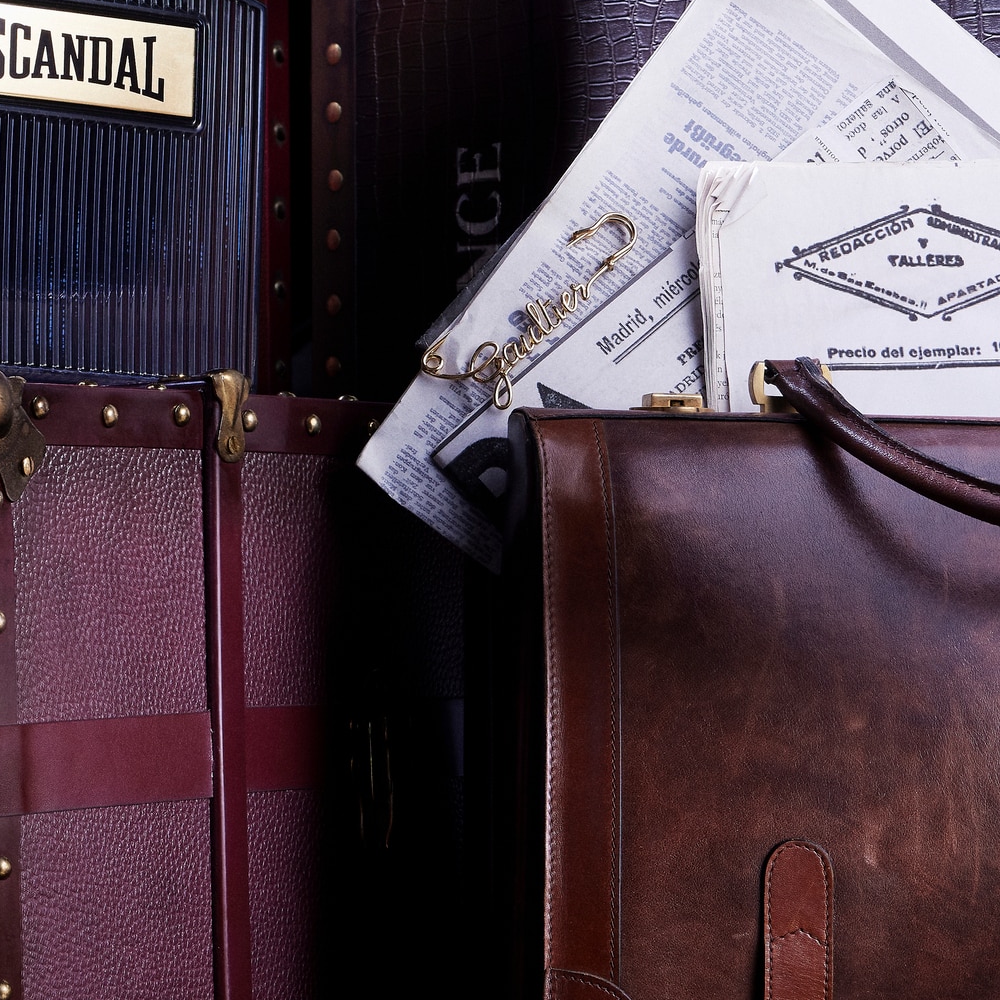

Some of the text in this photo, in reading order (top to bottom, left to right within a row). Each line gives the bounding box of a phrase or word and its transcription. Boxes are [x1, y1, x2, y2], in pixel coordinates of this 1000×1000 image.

[668, 80, 703, 110] geheißen
[700, 106, 742, 141] willkommen
[819, 218, 914, 262] REDACCIÓN
[887, 254, 965, 267] TALLERES
[596, 307, 654, 356] Madrid,
[827, 347, 877, 359] Precio
[881, 347, 905, 359] del
[908, 345, 981, 360] ejemplar:
